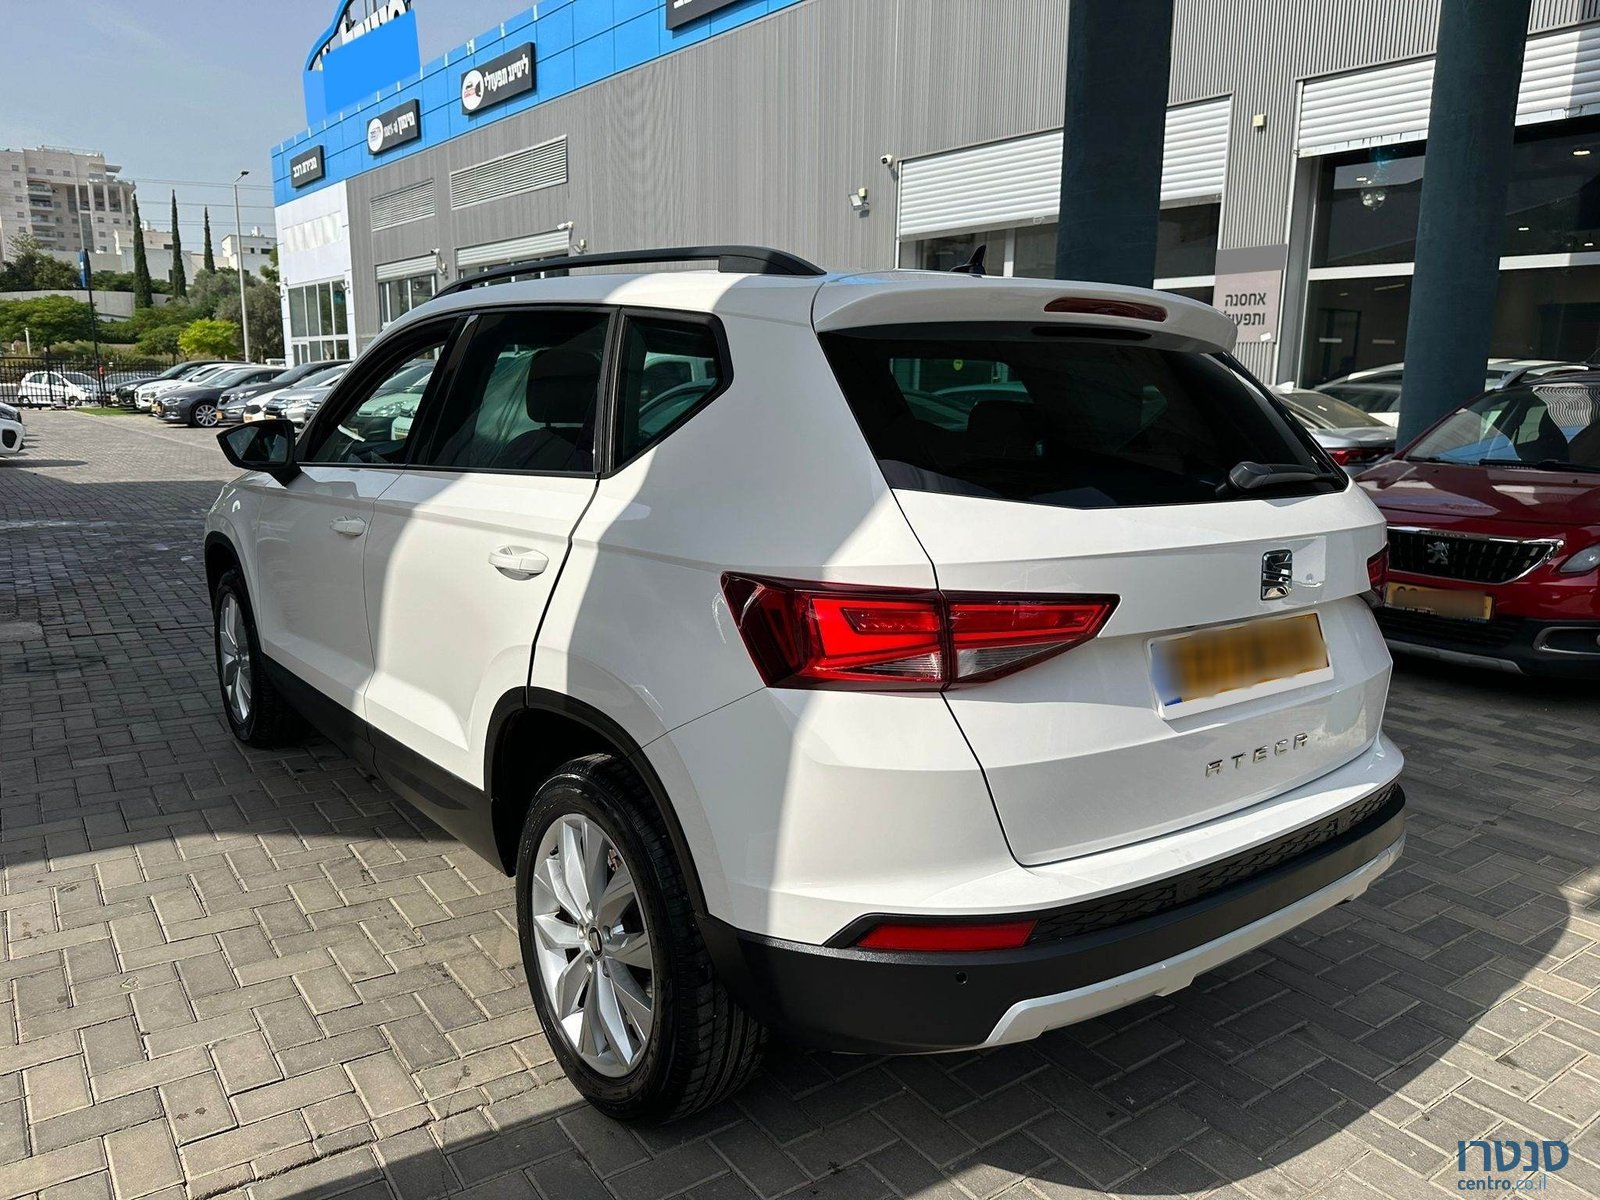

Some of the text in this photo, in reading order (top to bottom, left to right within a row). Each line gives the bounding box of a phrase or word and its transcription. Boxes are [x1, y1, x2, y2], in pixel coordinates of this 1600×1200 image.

[508, 53, 529, 82] ליסינג
[1224, 292, 1267, 307] אחסנה
[1205, 733, 1309, 778] ATECA
